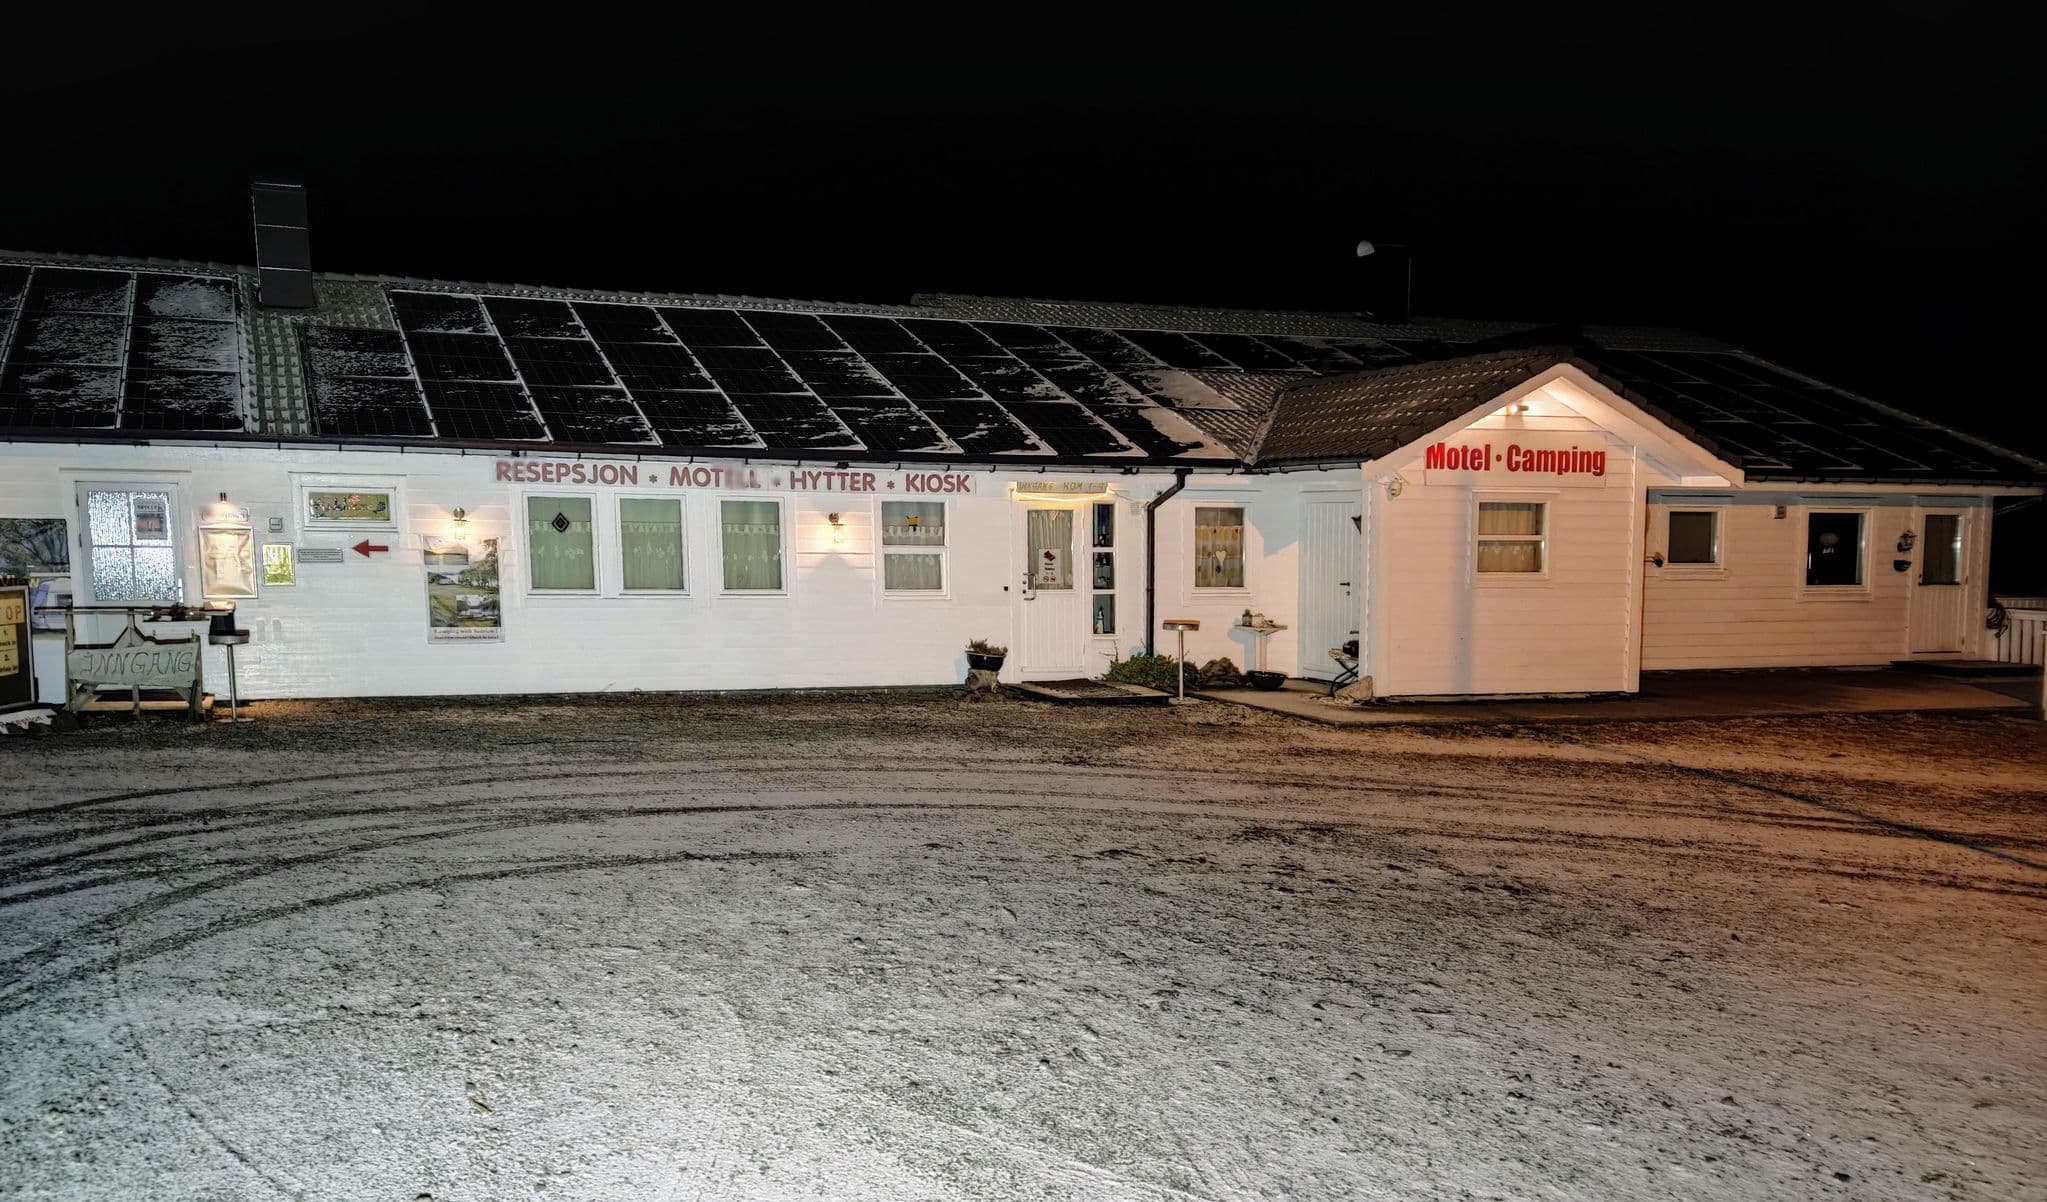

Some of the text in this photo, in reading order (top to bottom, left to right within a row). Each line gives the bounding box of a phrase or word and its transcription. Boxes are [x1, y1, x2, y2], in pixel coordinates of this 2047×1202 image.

[1426, 442, 1606, 477] Motel Camping
[496, 460, 971, 494] RESEPSJON MOTL HYTTER KIOSK
[79, 650, 193, 676] INNGANG
